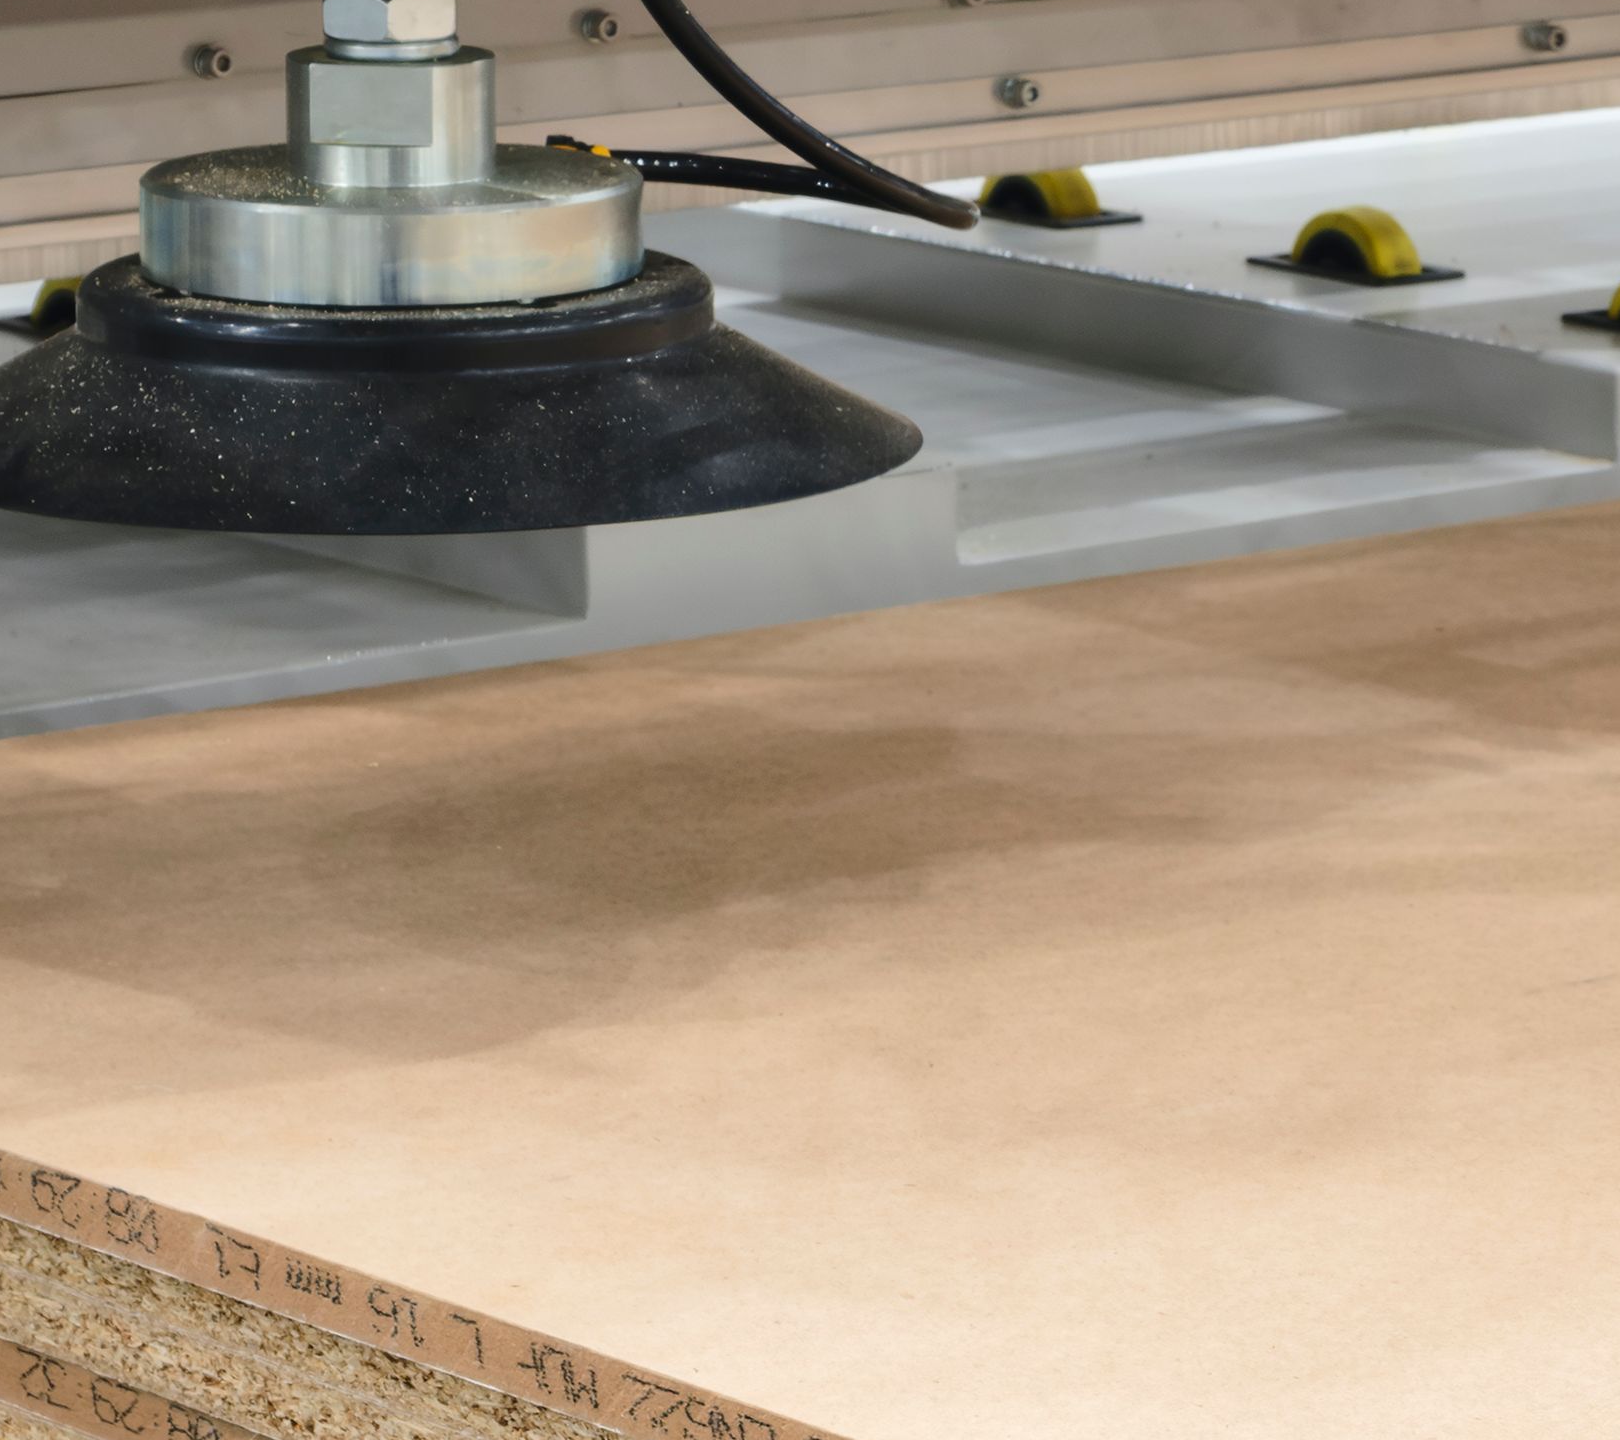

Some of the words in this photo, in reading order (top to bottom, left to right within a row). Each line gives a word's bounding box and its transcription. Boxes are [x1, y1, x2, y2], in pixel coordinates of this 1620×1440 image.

[205, 1222, 261, 1292] E1
[285, 1256, 343, 1306] mm
[367, 1284, 426, 1349] 16
[448, 1312, 486, 1371] L
